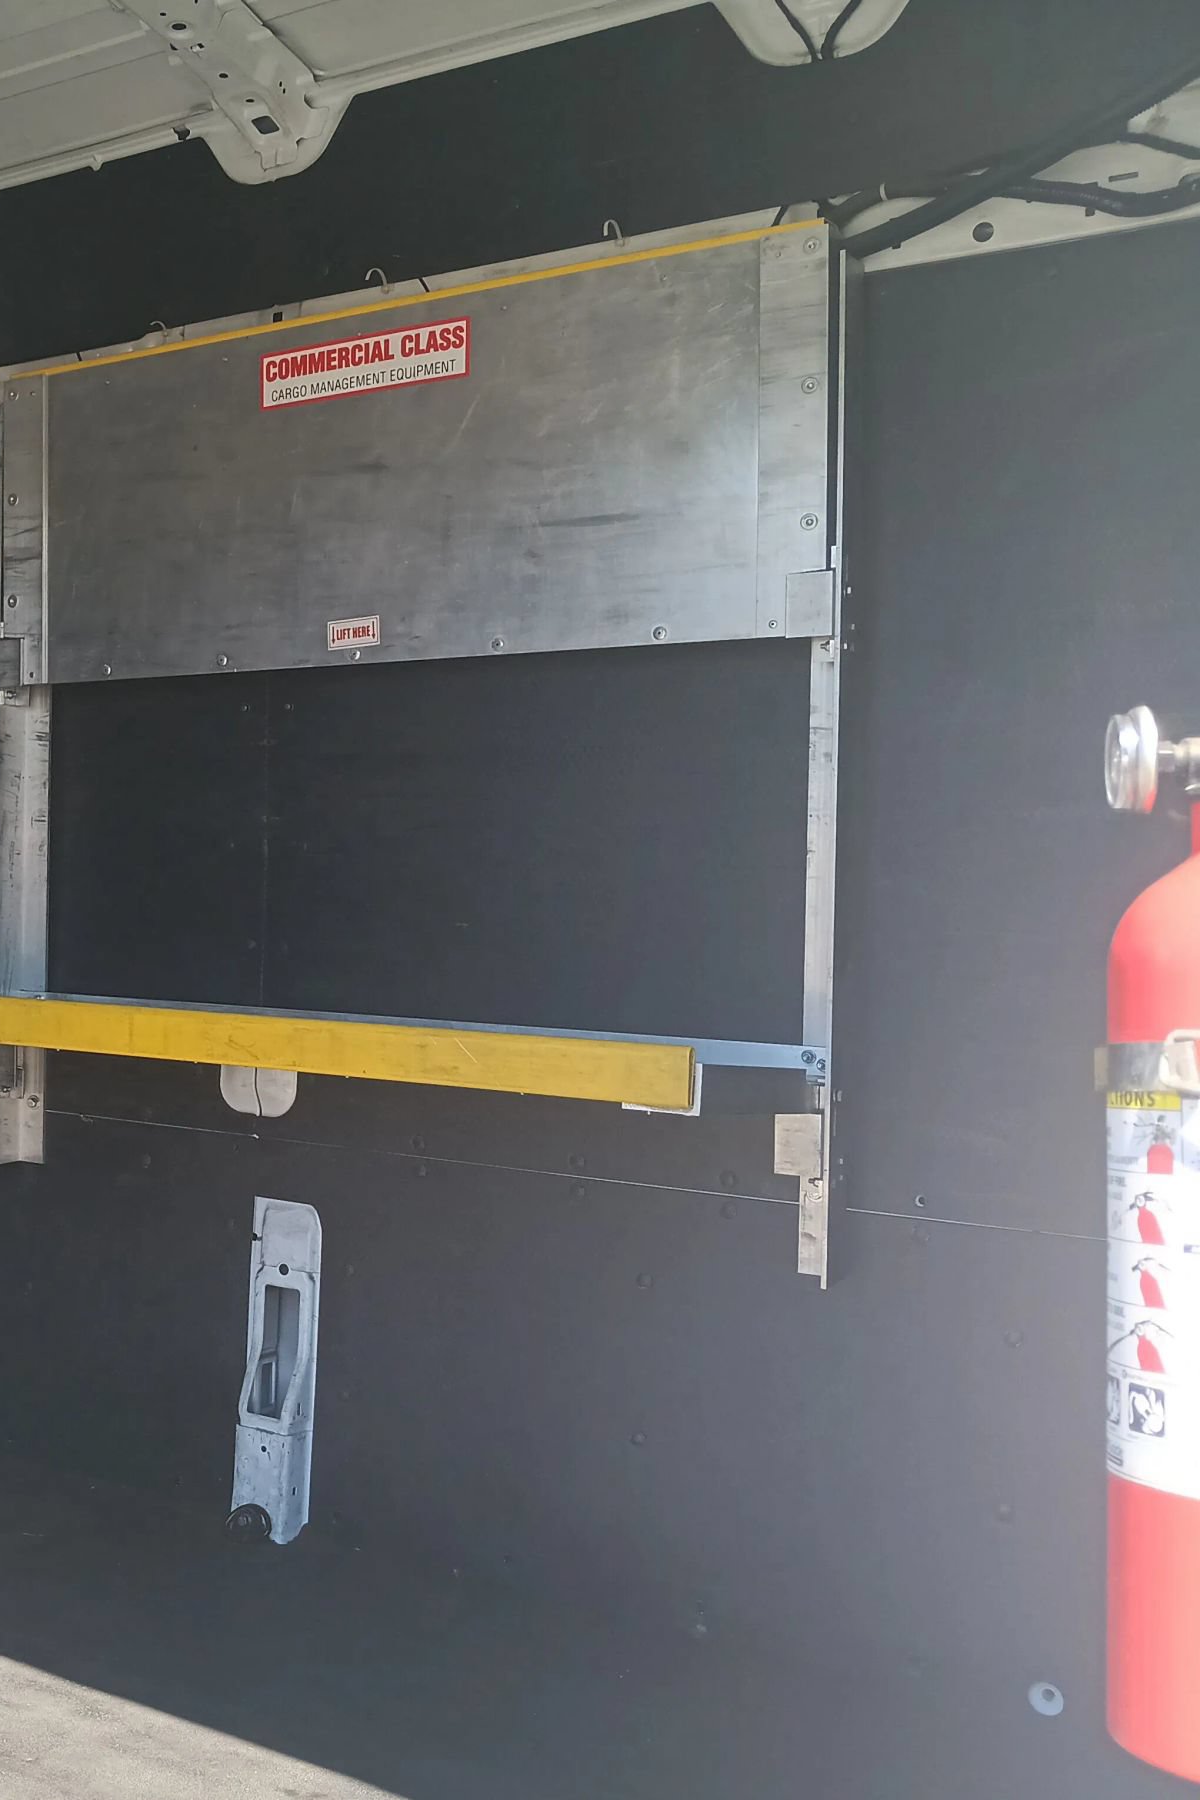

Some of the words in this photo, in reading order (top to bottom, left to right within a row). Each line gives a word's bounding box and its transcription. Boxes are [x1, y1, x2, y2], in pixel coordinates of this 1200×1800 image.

[265, 340, 395, 382] COMMERCIAL
[400, 325, 465, 358] CLASS
[271, 384, 308, 402] CARGO
[310, 371, 387, 395] MANAGEMENT
[390, 359, 457, 382] EQUIPMENT
[336, 628, 351, 641] LIFT
[352, 625, 371, 639] HERE
